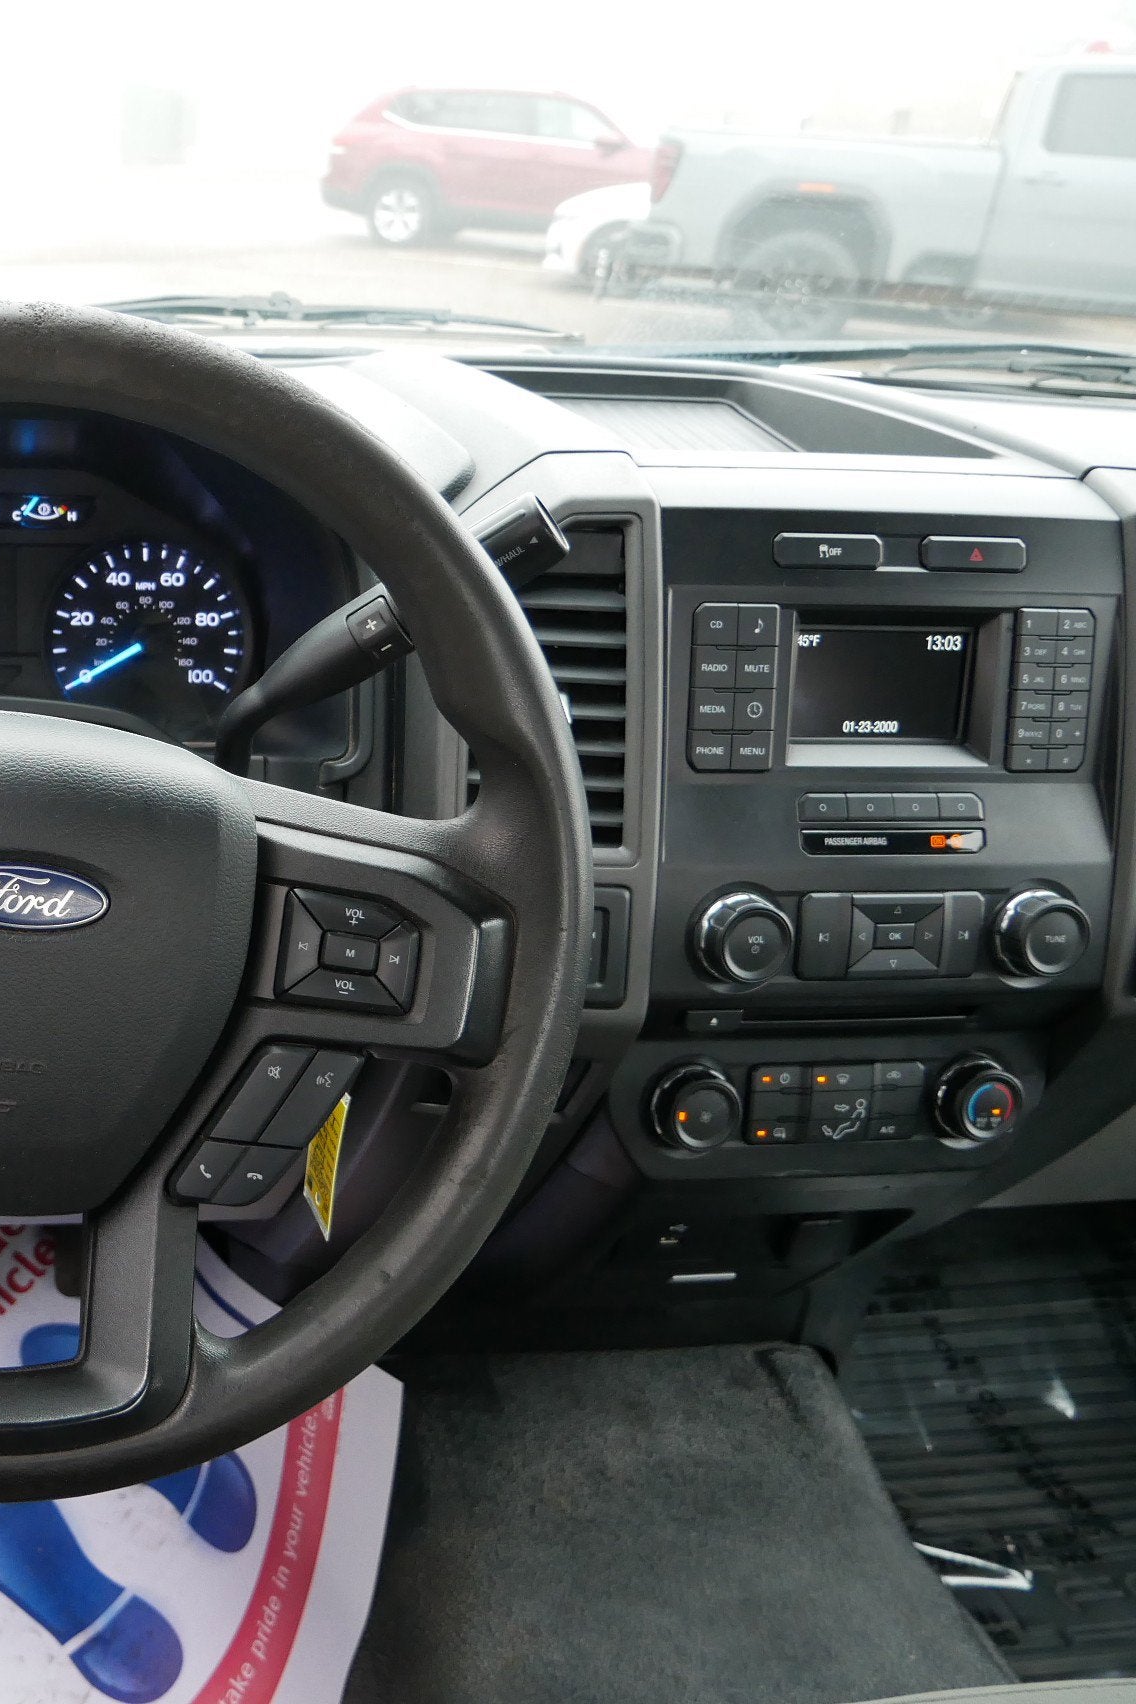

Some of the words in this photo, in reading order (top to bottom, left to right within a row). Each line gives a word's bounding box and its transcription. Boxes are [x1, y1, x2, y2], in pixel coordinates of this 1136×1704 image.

[12, 511, 22, 522] C
[67, 511, 77, 523] H
[828, 547, 843, 556] OFF
[105, 571, 131, 587] 40
[160, 572, 185, 587] 60
[135, 581, 157, 591] MPH
[115, 601, 130, 610] 60
[158, 601, 174, 610] 100
[70, 611, 94, 626] 20
[100, 616, 113, 626] 40
[177, 616, 191, 626] 120
[195, 612, 220, 627] 80
[709, 620, 723, 629] CD
[1025, 619, 1032, 629] 1
[1063, 619, 1071, 629] 2
[1073, 621, 1087, 629] ABC
[95, 637, 108, 646] 20
[182, 637, 198, 646] 140
[925, 635, 962, 651] 13:03
[1023, 646, 1031, 656] 3
[1061, 646, 1068, 656] 4
[701, 663, 728, 672] RADIO
[744, 664, 770, 673] MUTE
[188, 669, 214, 684] 100
[1022, 674, 1029, 684] 5
[1060, 674, 1067, 684] 6
[699, 705, 726, 714] MEDIA
[1020, 701, 1027, 711] 7
[842, 720, 898, 733] 01-23-2000
[1017, 728, 1024, 738] 9
[695, 746, 724, 755] PHONE
[739, 747, 765, 755] MENU
[824, 836, 863, 846] PASSENGER
[863, 837, 888, 846] AIRBAG
[345, 907, 366, 920] VOL
[747, 935, 764, 944] VOL
[888, 931, 902, 940] OK
[1044, 935, 1066, 944] TUNE
[345, 948, 356, 958] M
[334, 979, 355, 991] VOL
[879, 1125, 896, 1134] A/C
[250, 1594, 282, 1661] pride
[275, 1565, 291, 1590] in
[283, 1502, 304, 1559] your
